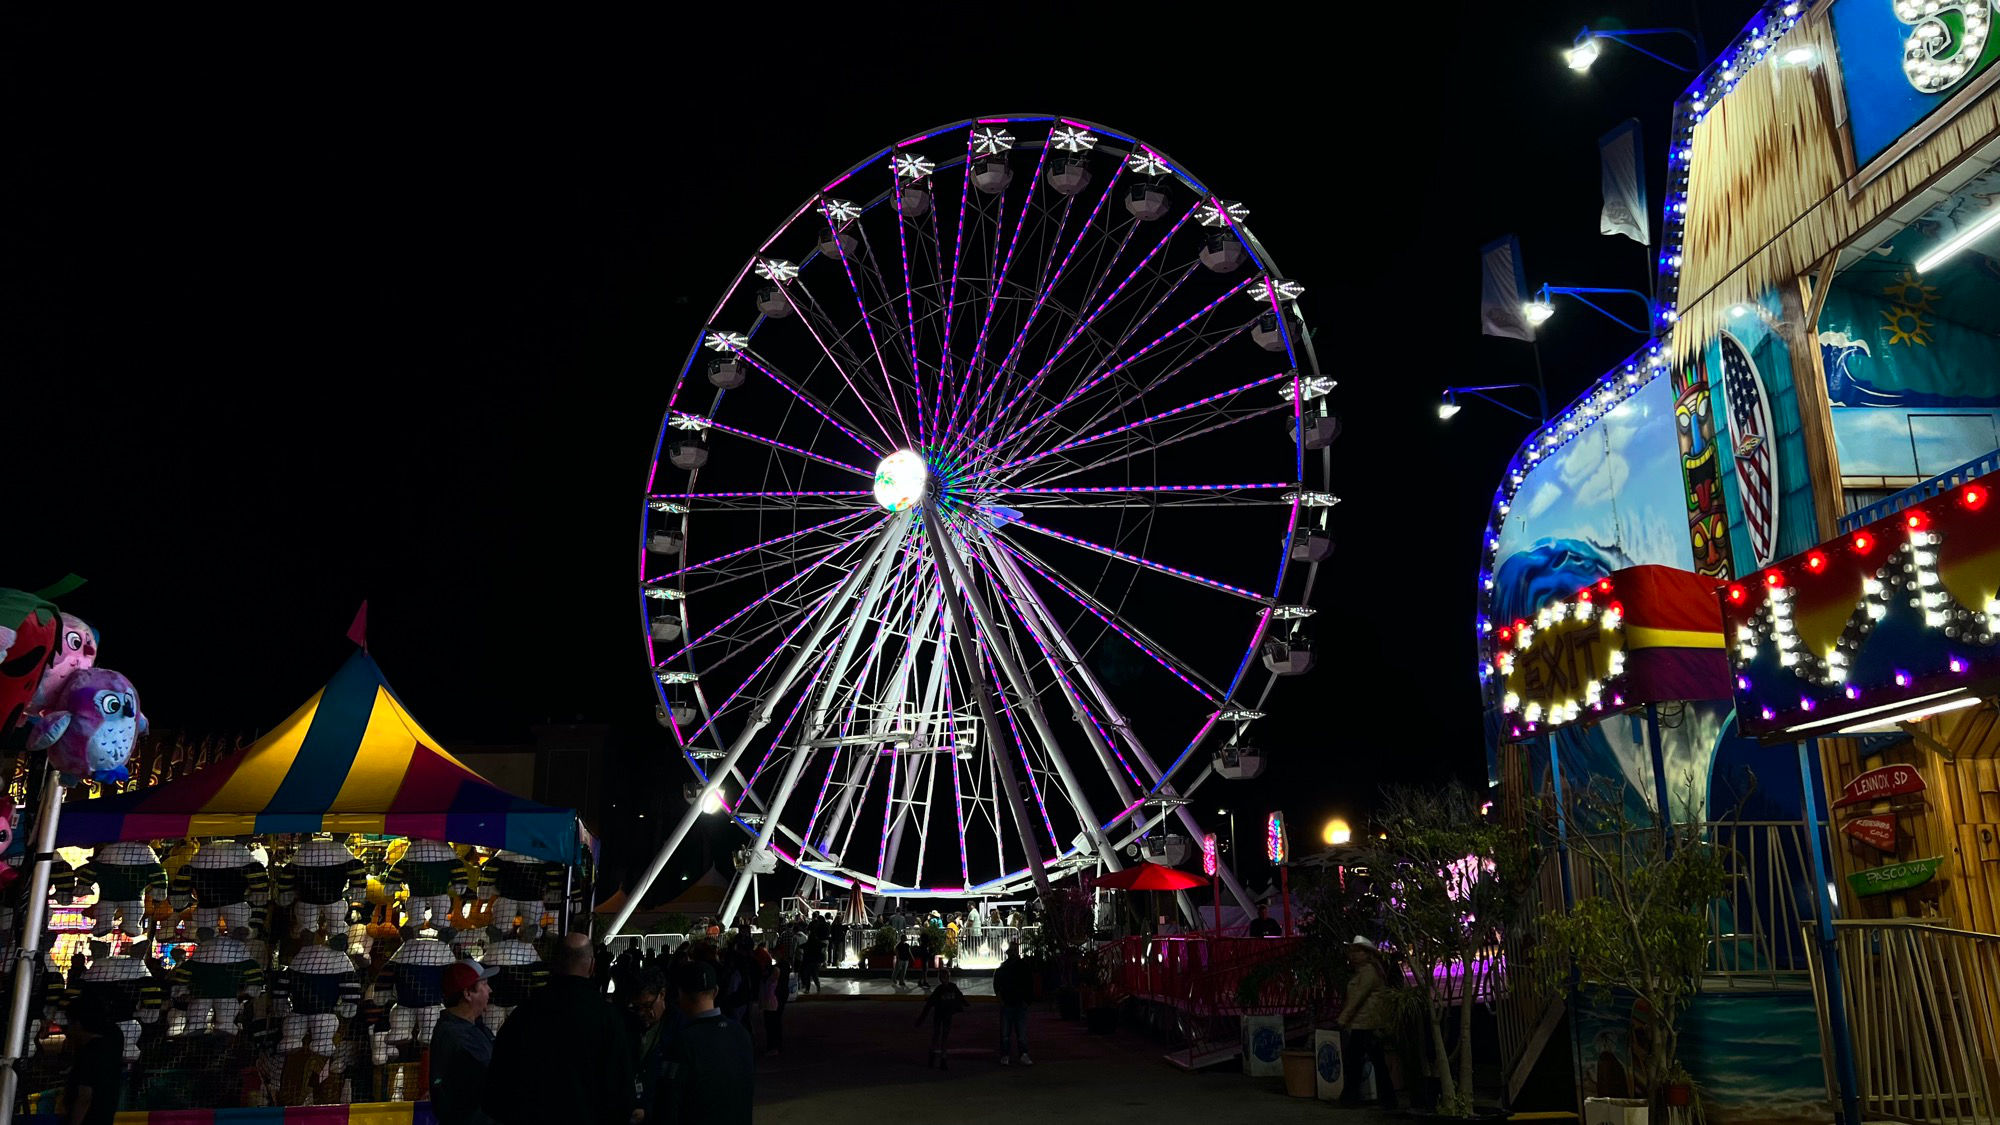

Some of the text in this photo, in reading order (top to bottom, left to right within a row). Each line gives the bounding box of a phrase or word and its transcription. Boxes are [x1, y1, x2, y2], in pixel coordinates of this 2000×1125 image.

[1521, 622, 1600, 699] EXIT
[1854, 773, 1890, 796] LENNOX
[1865, 866, 1906, 883] PASCO
